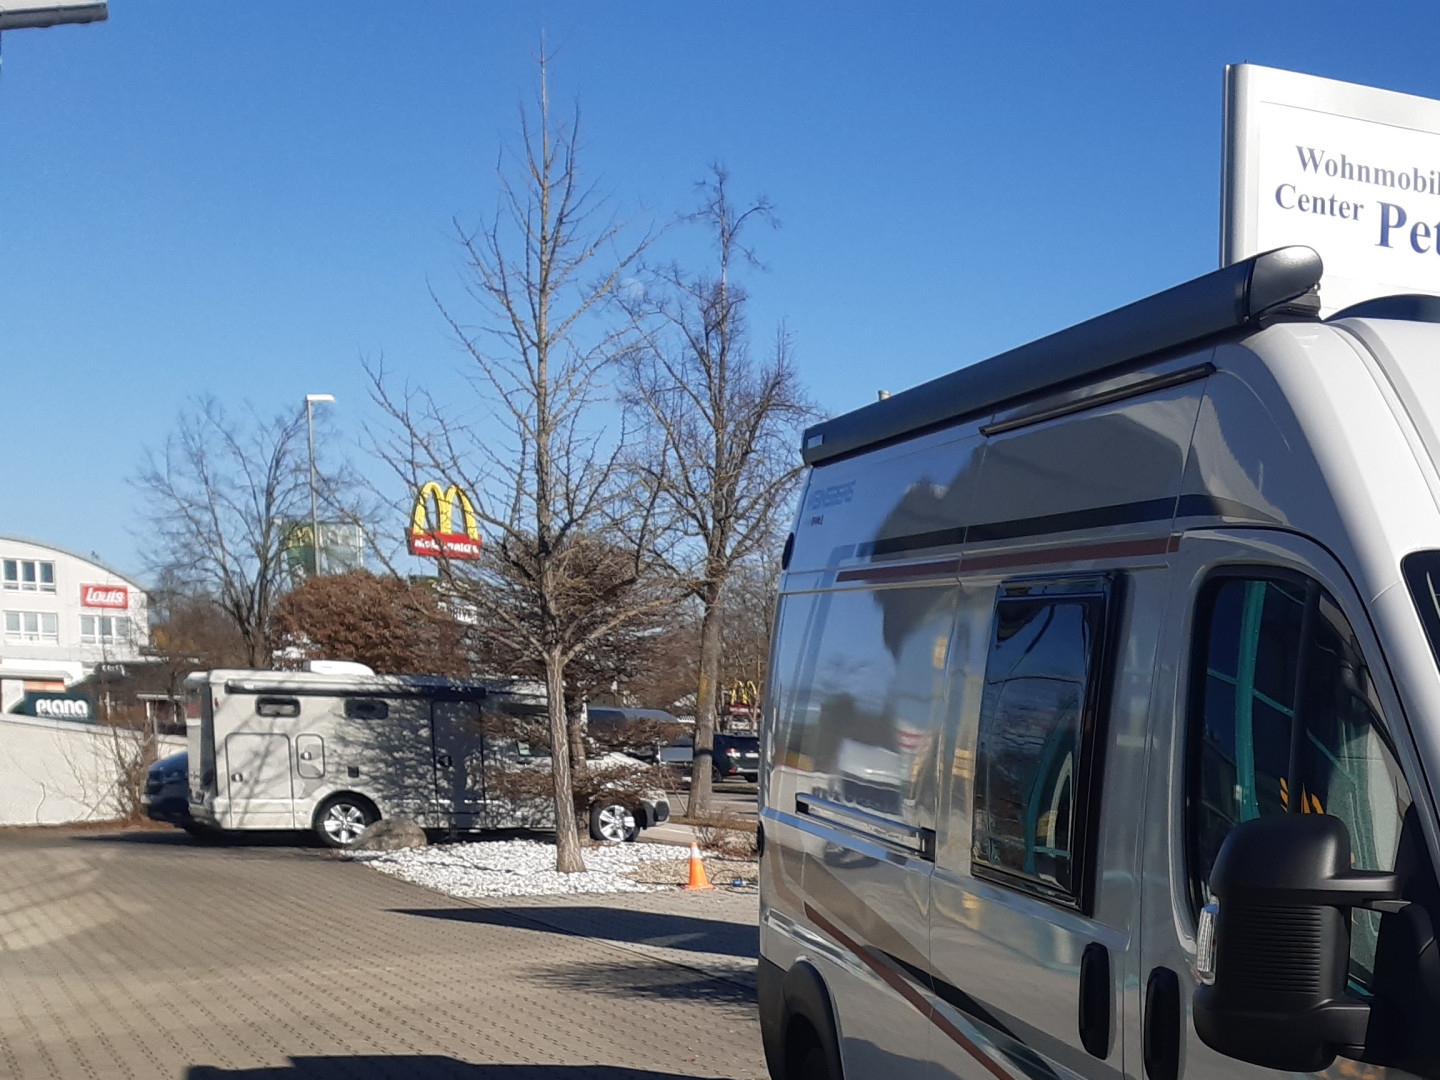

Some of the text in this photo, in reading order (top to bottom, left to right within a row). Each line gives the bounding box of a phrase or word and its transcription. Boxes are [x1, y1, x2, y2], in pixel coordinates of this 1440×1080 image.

[1274, 183, 1364, 222] Center
[414, 537, 479, 554] McDnald's
[85, 586, 126, 604] Louis
